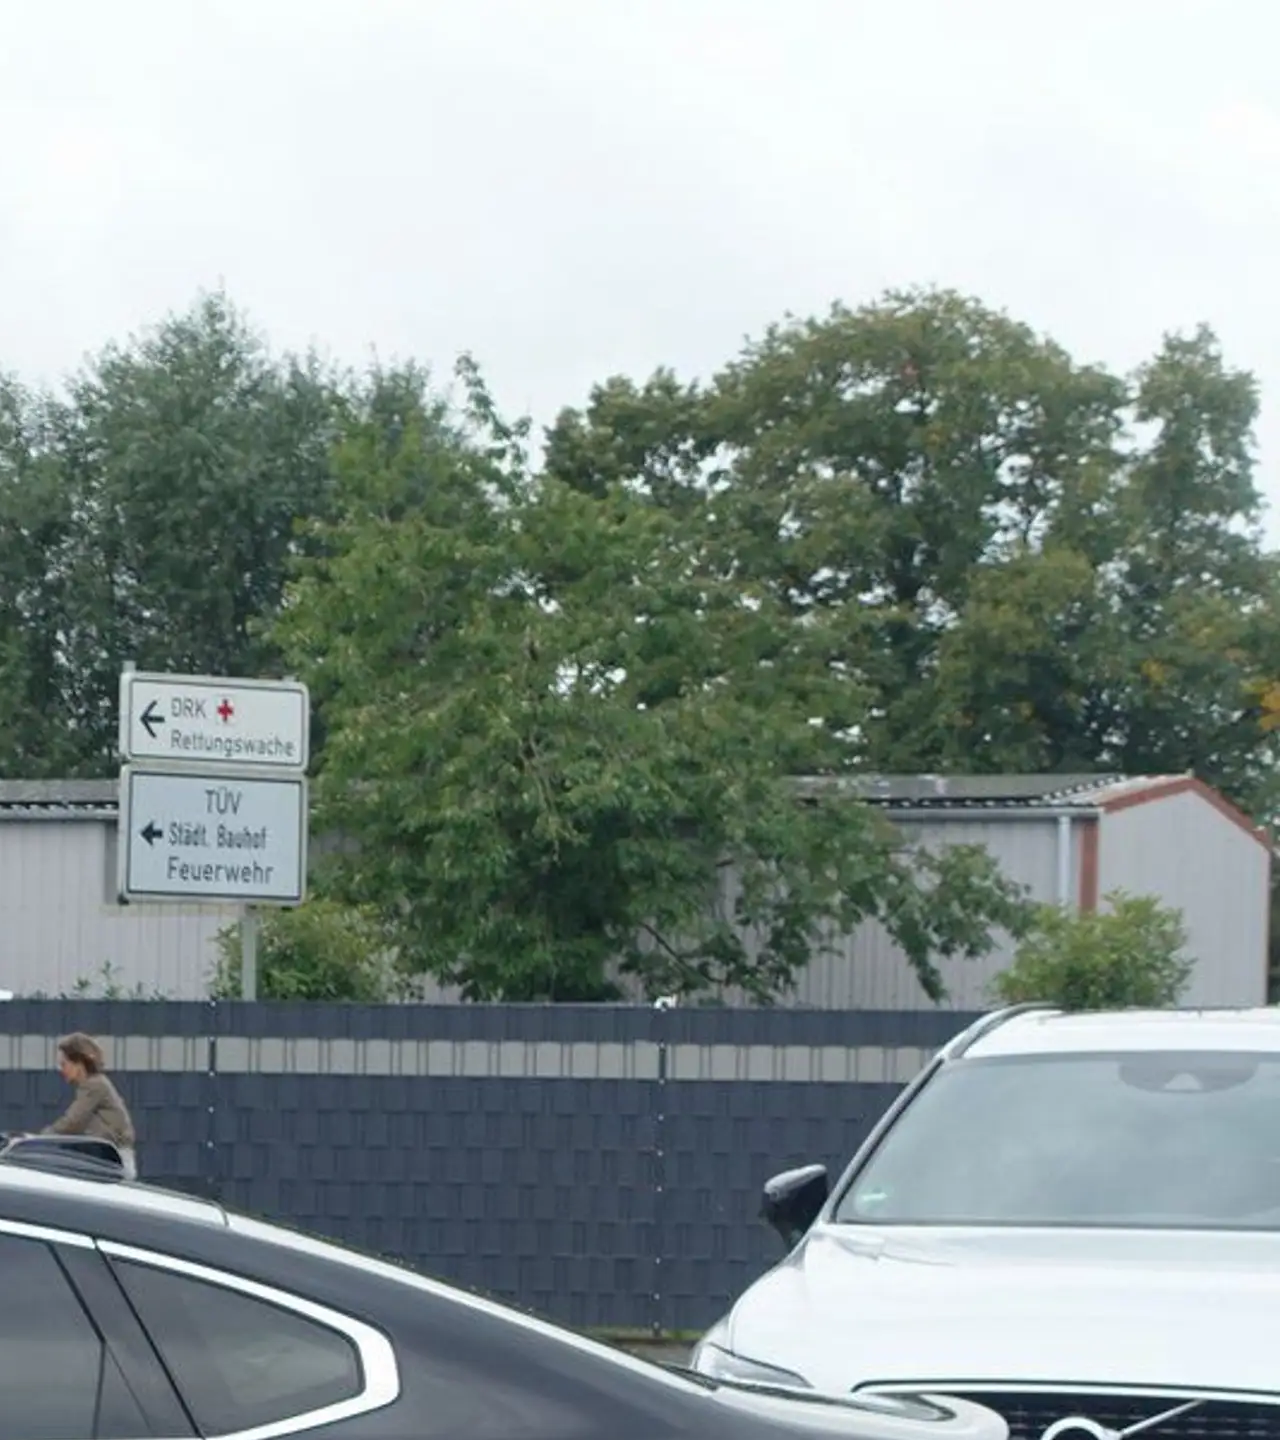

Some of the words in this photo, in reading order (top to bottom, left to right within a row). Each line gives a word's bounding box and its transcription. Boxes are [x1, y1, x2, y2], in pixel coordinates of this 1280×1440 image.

[170, 697, 206, 719] DRK
[170, 729, 295, 758] Rettungswache
[204, 785, 242, 815] TÜV
[216, 822, 266, 849] Bauhof
[166, 856, 275, 885] Feuerwehr
